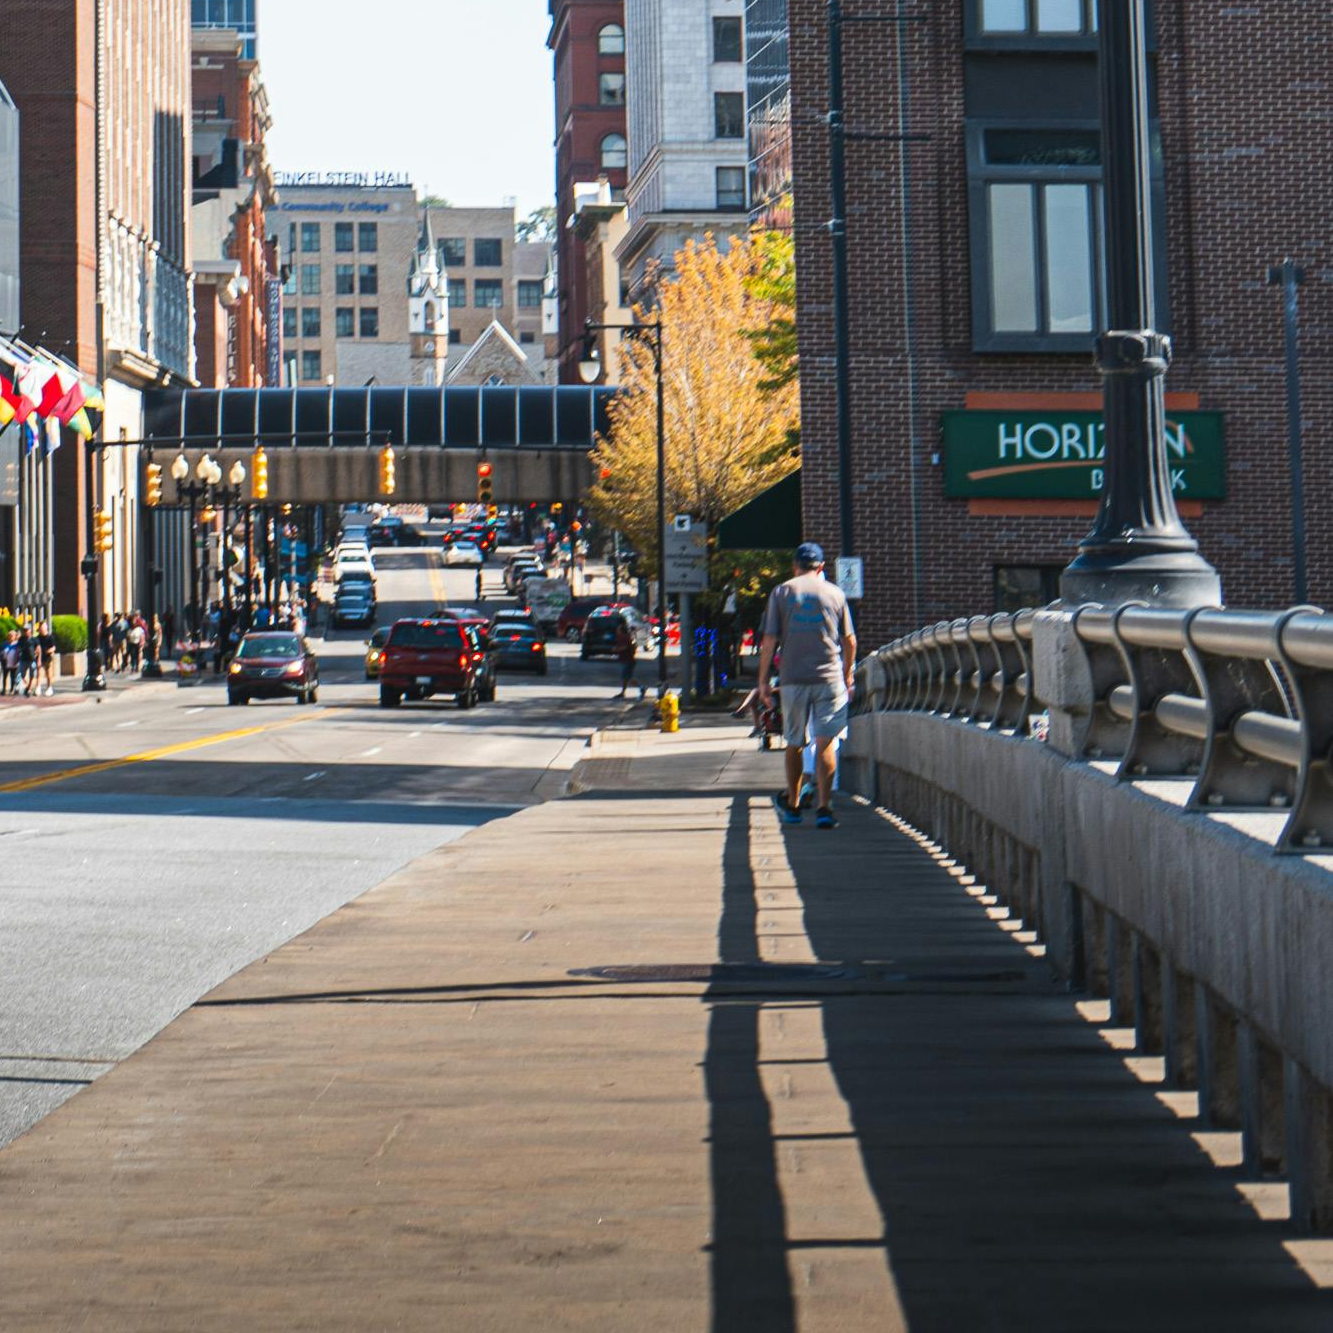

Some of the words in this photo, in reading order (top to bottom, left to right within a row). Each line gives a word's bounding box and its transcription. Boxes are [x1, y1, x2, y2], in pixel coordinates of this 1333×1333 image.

[375, 170, 410, 186] HALL
[998, 422, 1186, 459] HORIN
[1090, 468, 1187, 491] BK
